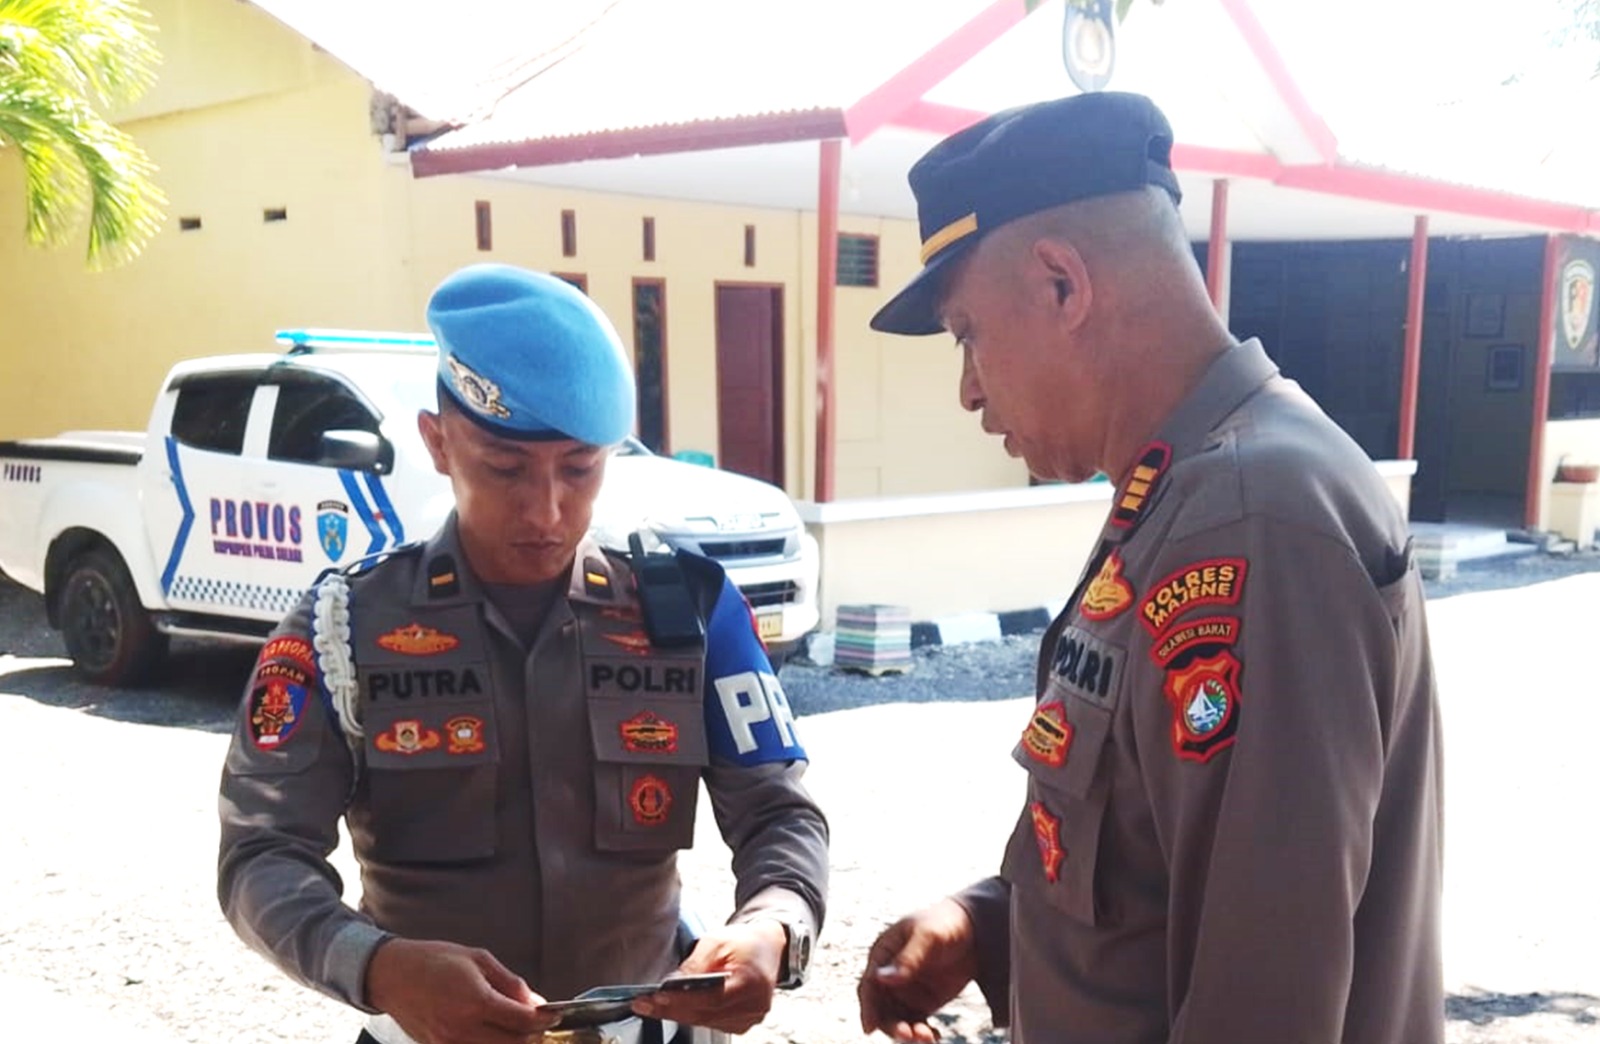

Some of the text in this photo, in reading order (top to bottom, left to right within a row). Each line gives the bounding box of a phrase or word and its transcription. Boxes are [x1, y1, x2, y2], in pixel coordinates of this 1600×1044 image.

[4, 463, 42, 483] PROVOS
[210, 497, 302, 545] PROVOS
[1144, 565, 1235, 620] POLRES
[1154, 582, 1231, 628] MAJENE
[1197, 624, 1231, 637] BARAT
[368, 667, 483, 701] PUTRA
[591, 663, 696, 694] POLRI
[1053, 632, 1114, 699] POLRI
